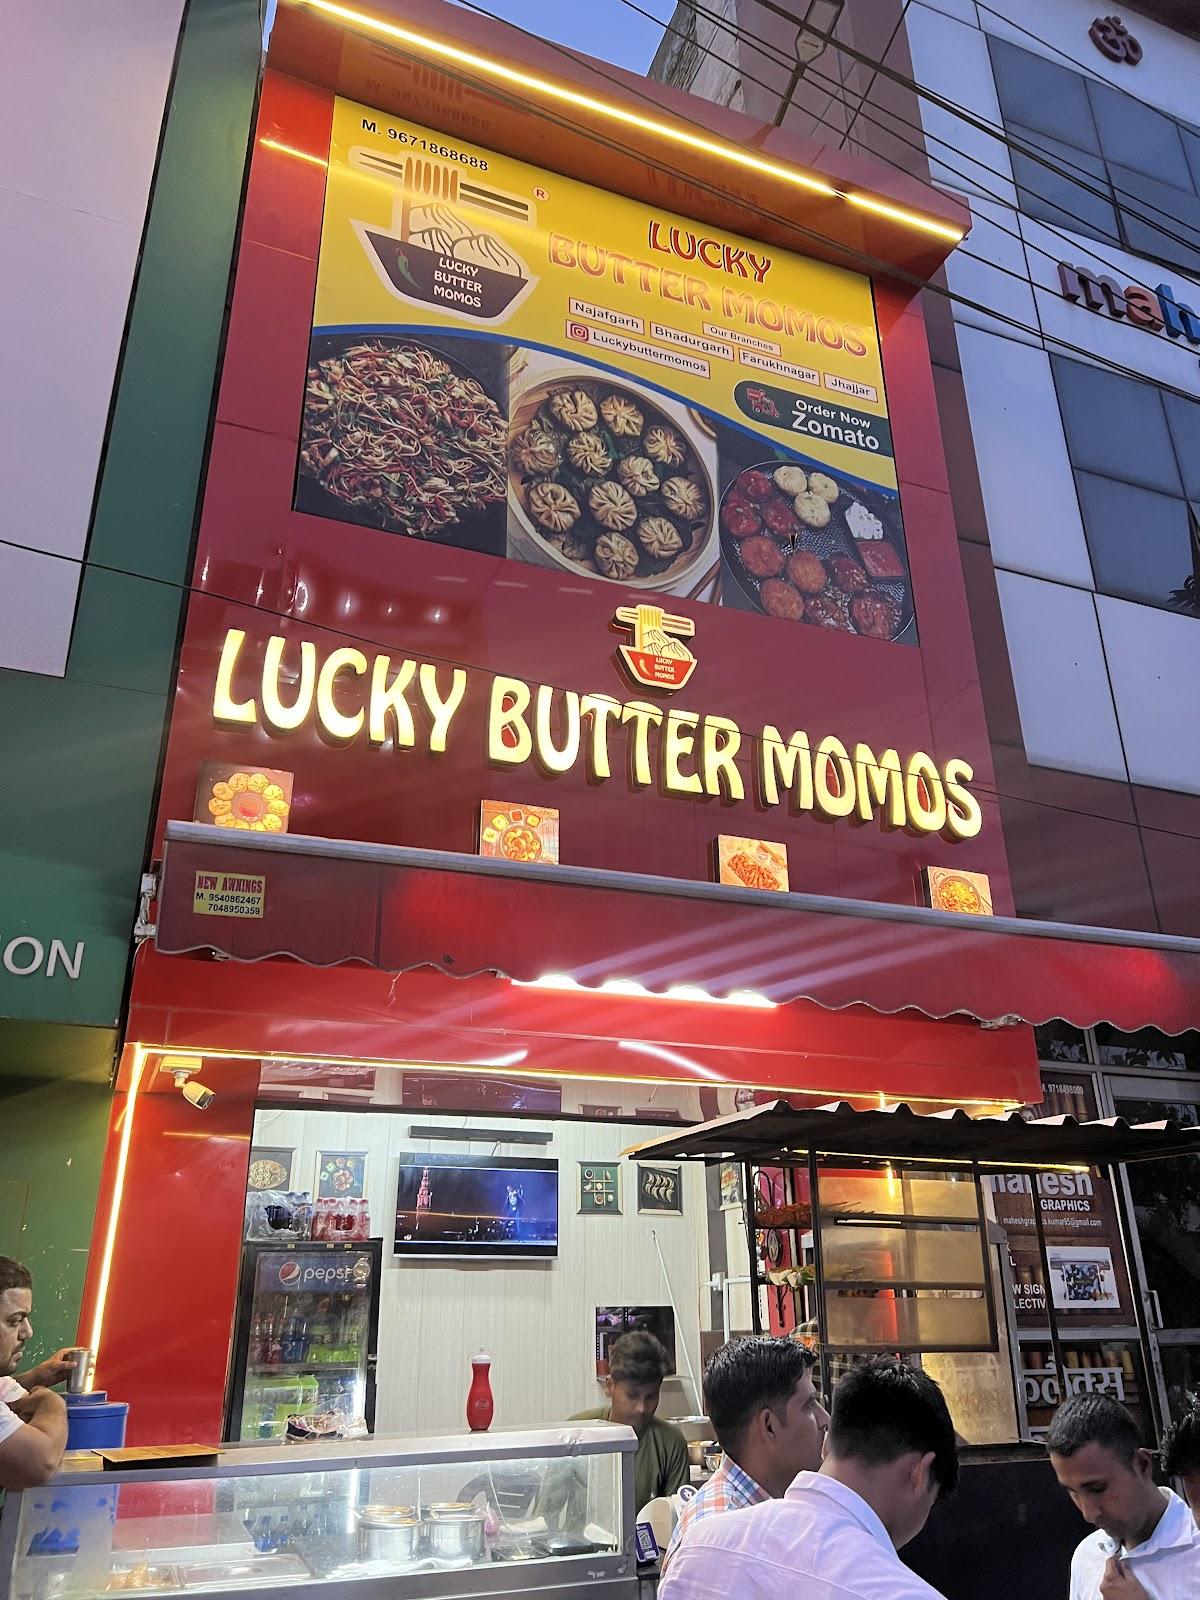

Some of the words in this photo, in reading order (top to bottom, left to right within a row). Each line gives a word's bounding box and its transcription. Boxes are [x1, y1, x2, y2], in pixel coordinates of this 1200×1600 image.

[361, 118, 382, 134] M.
[388, 127, 488, 171] 9671868688
[648, 220, 772, 283] LUCKY
[439, 257, 479, 278] LUCKY
[434, 270, 483, 294] BUTTER
[549, 231, 711, 312] BUTTER
[721, 286, 867, 357] MOMOS
[433, 285, 482, 308] MOMOS
[574, 301, 640, 330] Najafgarh
[654, 326, 730, 357] Bhadurgarh
[742, 351, 816, 381] Farukhnagar
[831, 378, 870, 397] Jhajjar
[710, 326, 728, 338] Our
[730, 330, 774, 352] Branches
[593, 331, 707, 373] Luckybuttermomos
[796, 399, 837, 420] Order
[839, 408, 871, 428] Now
[792, 410, 880, 451] Zomato
[654, 664, 675, 673] BUTTER
[656, 657, 672, 665] LUCKY
[654, 671, 675, 680] MOMOS
[213, 628, 467, 753] LUCKY
[488, 675, 745, 801] BUTTER
[763, 724, 983, 840] MOMOS
[197, 875, 218, 890] NEW
[222, 876, 263, 894] AWNINGS
[196, 892, 206, 901] M.
[209, 893, 261, 905] 9540862467
[208, 903, 260, 915] 7048950359
[0, 936, 84, 978] ON
[1040, 1199, 1090, 1212] GRAPHICS
[304, 1265, 348, 1283] pepsi
